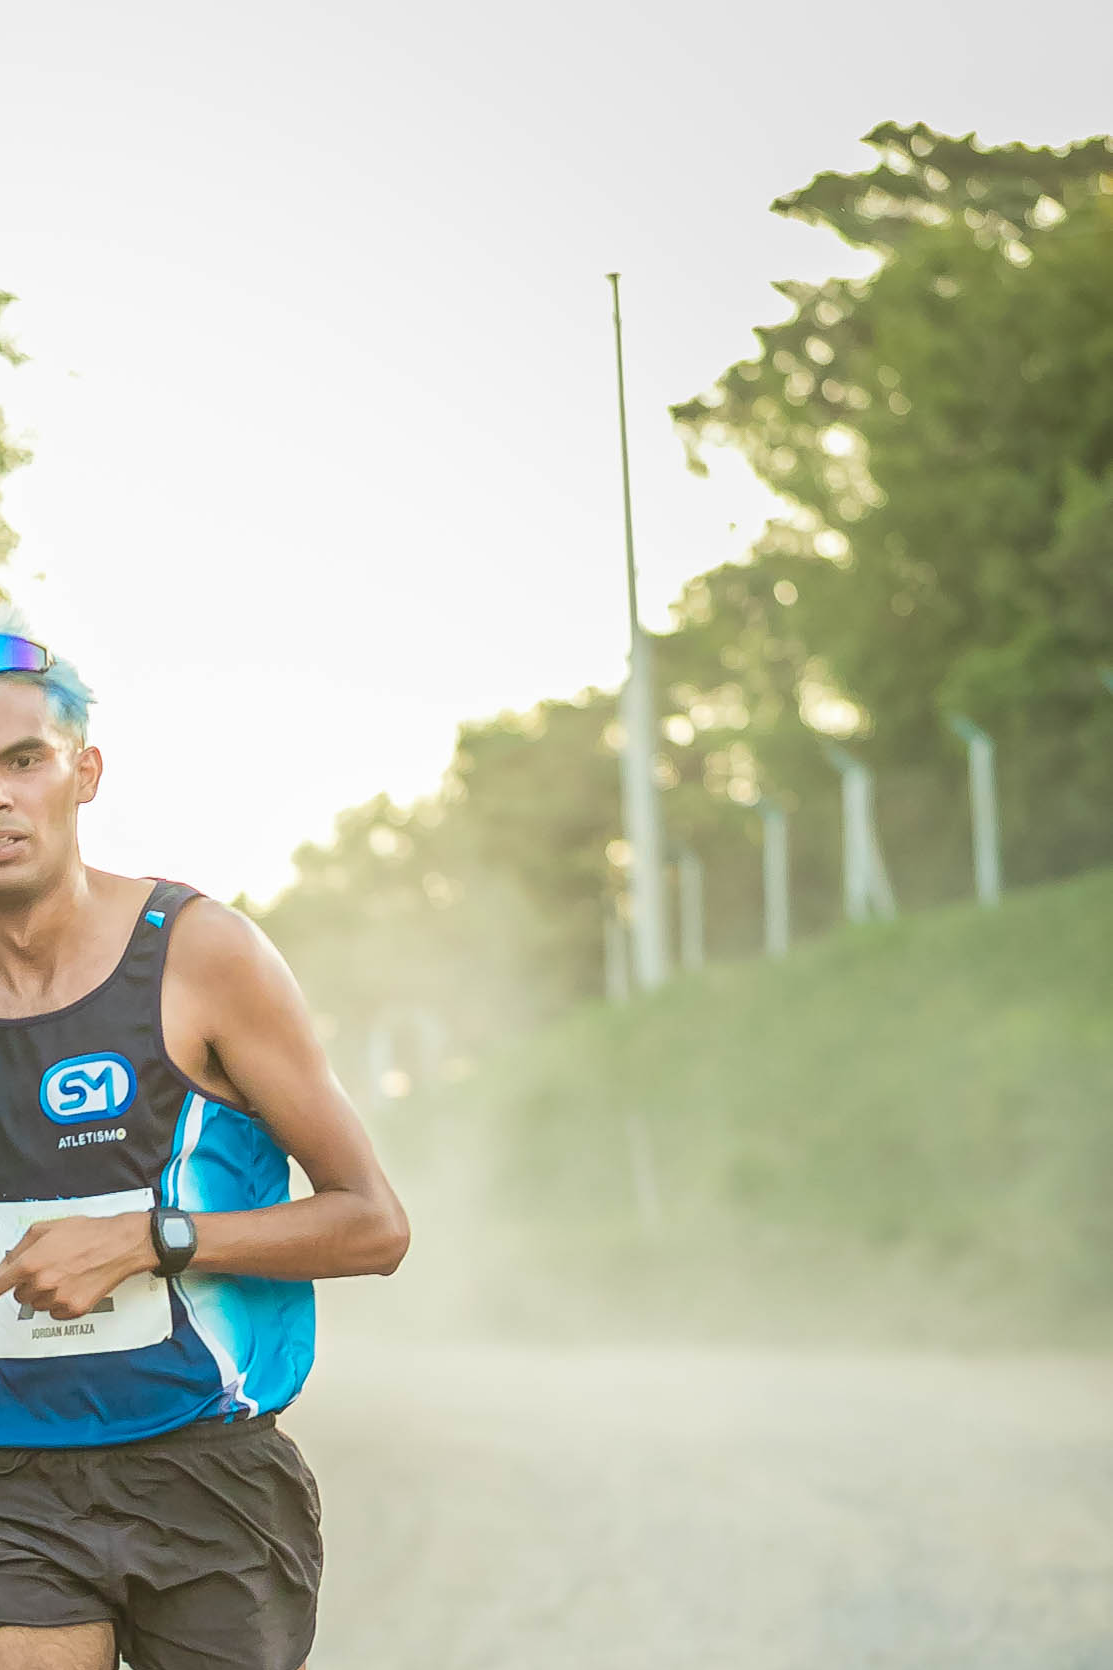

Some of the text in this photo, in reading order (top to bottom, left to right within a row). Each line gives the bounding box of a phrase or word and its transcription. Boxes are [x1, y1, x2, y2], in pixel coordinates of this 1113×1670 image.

[58, 1127, 127, 1149] ATLETISMO
[31, 1323, 96, 1340] JORDAN ARTAZA
